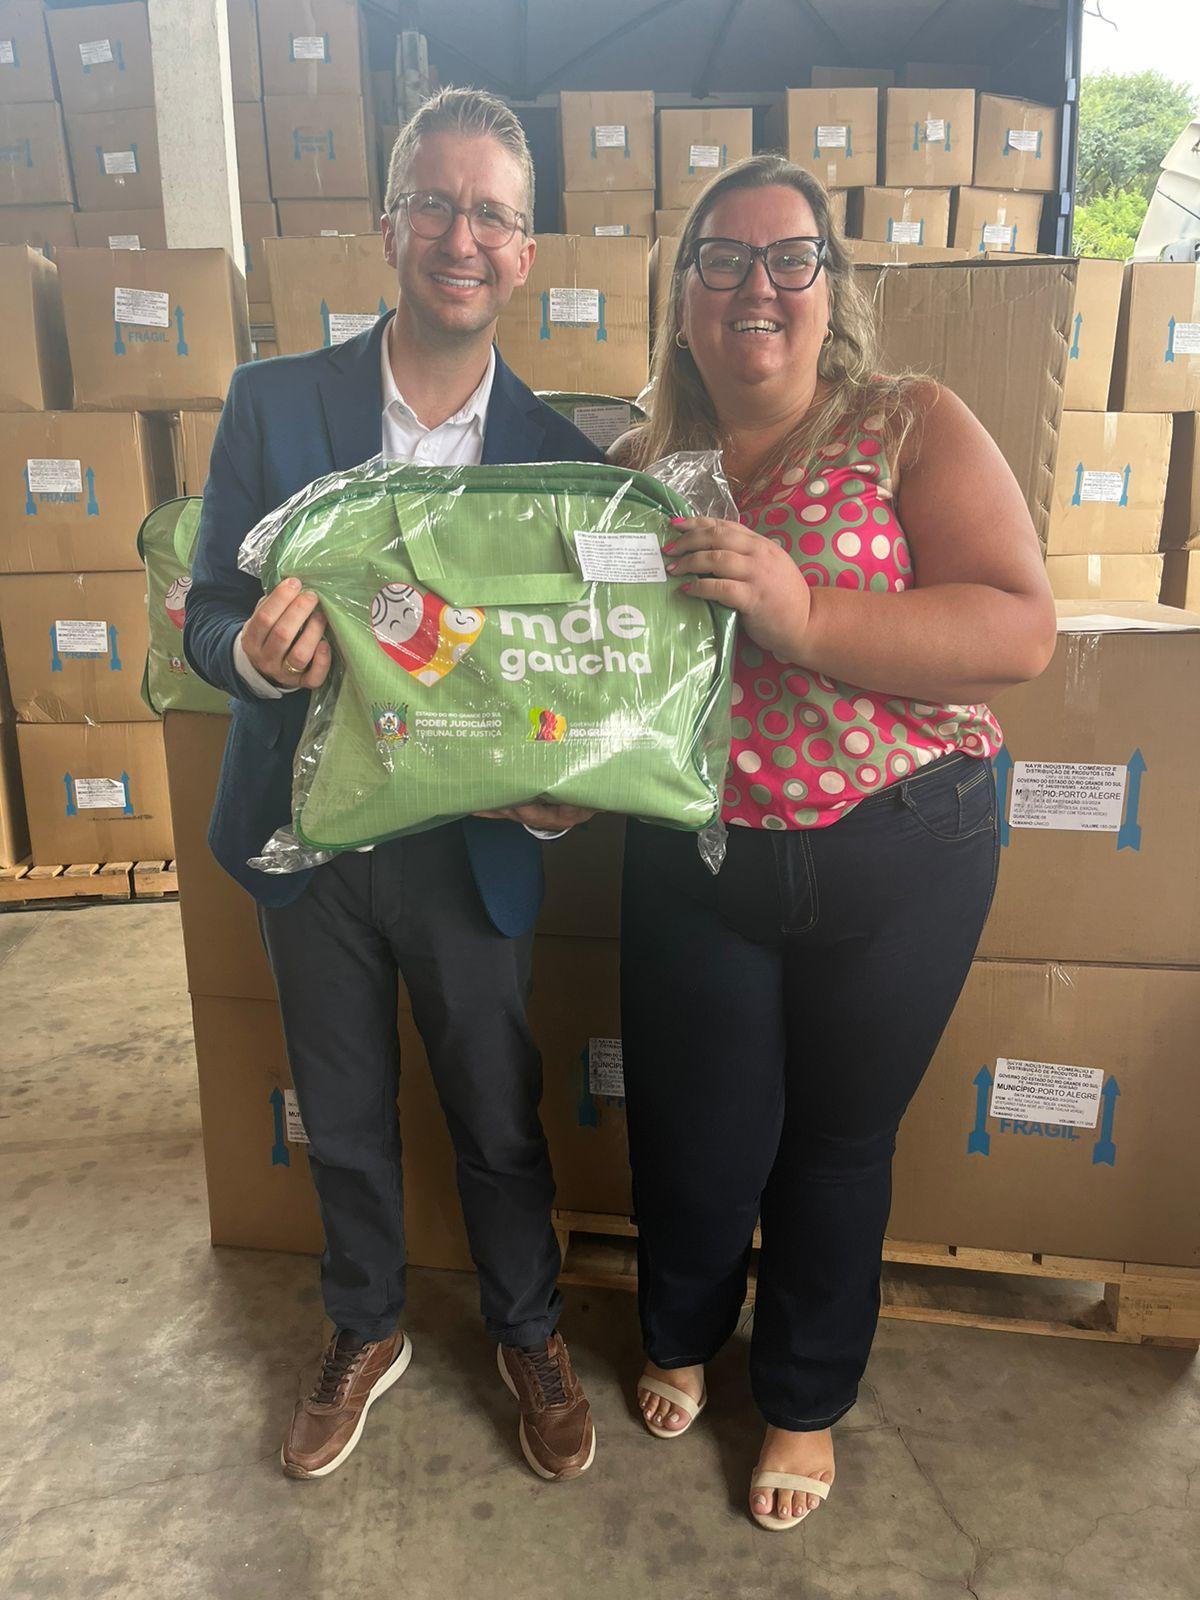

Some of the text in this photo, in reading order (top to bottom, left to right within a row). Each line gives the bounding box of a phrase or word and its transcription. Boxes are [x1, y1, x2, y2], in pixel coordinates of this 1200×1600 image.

[498, 599, 650, 644] mãe
[500, 646, 652, 681] gaúcha
[415, 719, 502, 728] PODER JUDICIÁRIO
[416, 729, 454, 737] TRIBUNAL
[469, 729, 502, 738] JUSTIÇA
[1088, 792, 1121, 800] ALEGRE
[1007, 1066, 1042, 1074] DISTRIBUIÇÃO
[1051, 1070, 1078, 1078] PRODUTOS
[1066, 1091, 1098, 1101] ALEGRE
